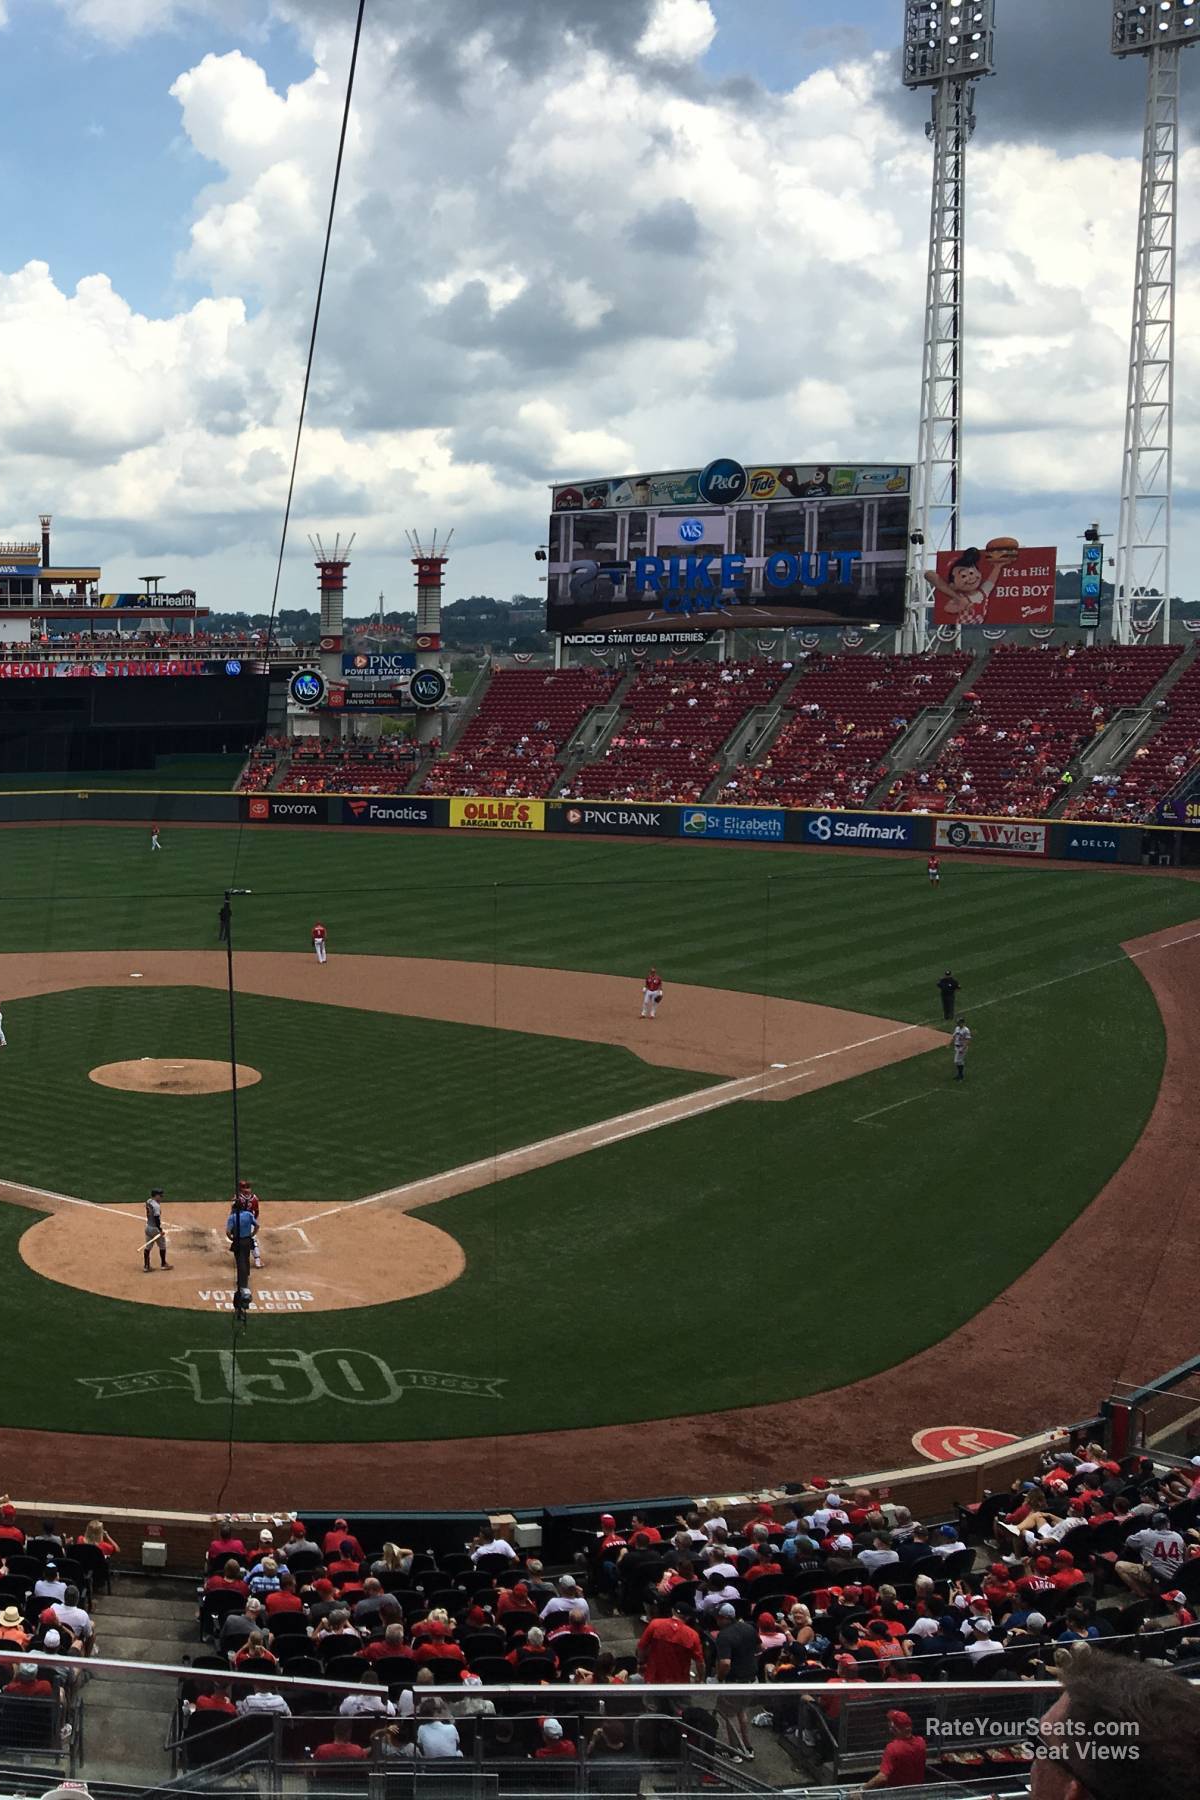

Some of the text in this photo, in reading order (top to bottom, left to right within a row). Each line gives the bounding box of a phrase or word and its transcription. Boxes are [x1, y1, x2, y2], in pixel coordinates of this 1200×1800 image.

[709, 473, 741, 490] P&G
[751, 477, 776, 494] Tide
[765, 551, 862, 589] OUT
[1003, 567, 1019, 577] It's
[1029, 566, 1049, 576] Hit!
[1087, 562, 1098, 575] K
[996, 585, 1049, 597] BIG BOY
[150, 594, 195, 607] TriHealth
[564, 631, 706, 643] NOCO START DEAD BATTERIES.
[370, 656, 402, 668] PNC
[105, 661, 205, 677] STRIKEOUT
[272, 804, 317, 815] TOYOTA
[370, 805, 427, 820] Fanatics
[460, 819, 532, 829] BARGAIN OUTLET
[724, 816, 781, 831] Elizabeth
[834, 822, 906, 840] Staffmark
[954, 829, 965, 839] 45
[979, 825, 1043, 844] Wyler
[1082, 840, 1116, 848] DELTA
[257, 1290, 314, 1301] REDS
[171, 1348, 403, 1405] 150
[1153, 1541, 1180, 1562] 44
